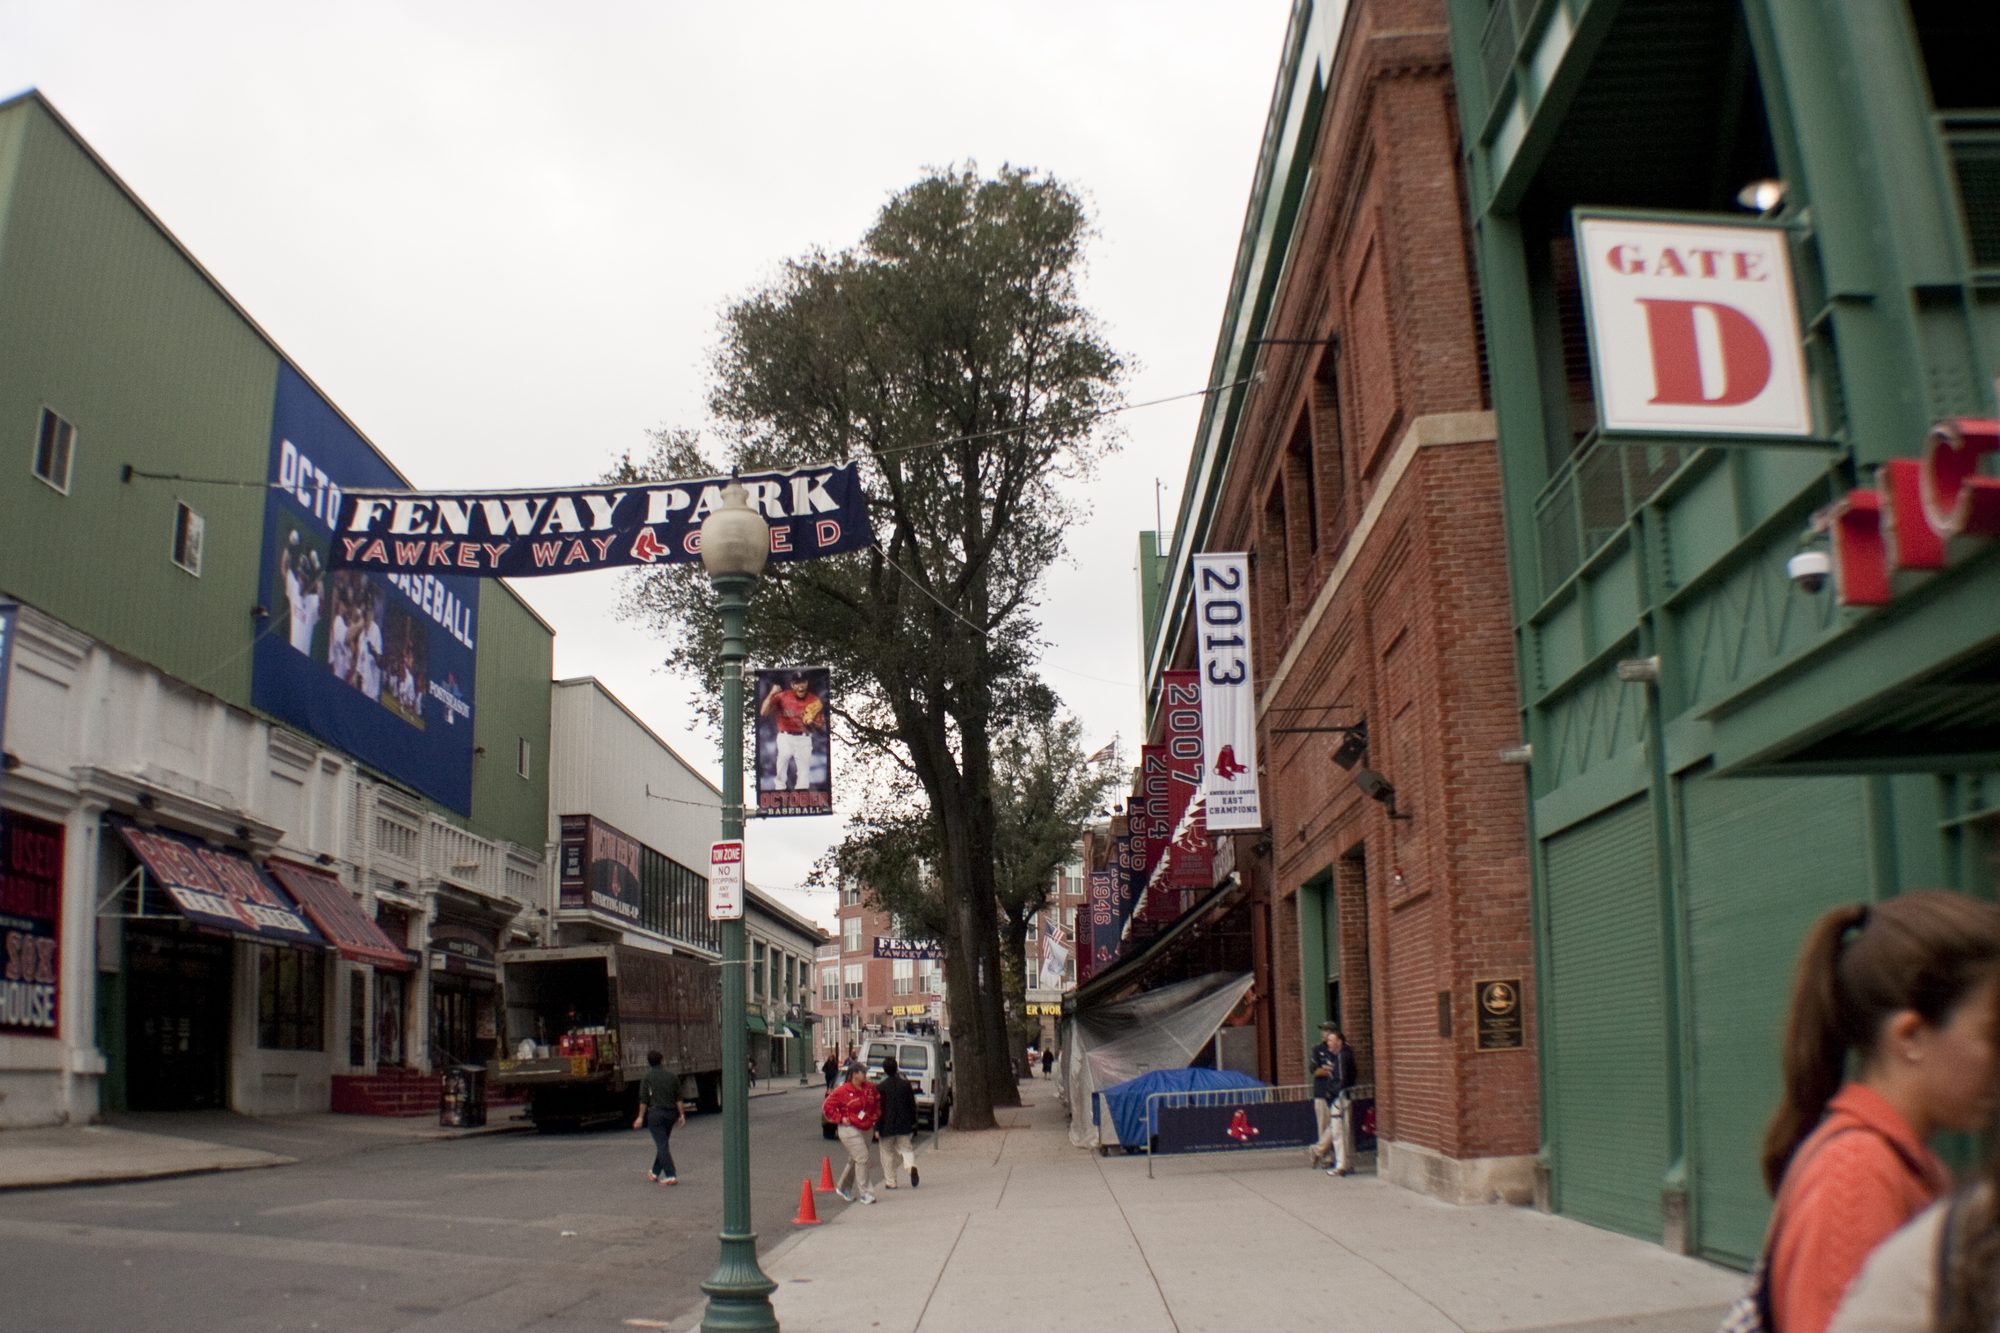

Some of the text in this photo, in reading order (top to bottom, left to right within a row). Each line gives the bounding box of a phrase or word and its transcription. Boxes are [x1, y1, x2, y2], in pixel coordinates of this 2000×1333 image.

[1606, 244, 1769, 283] GATE
[1634, 297, 1773, 407] D
[279, 438, 343, 532] OCTO
[347, 472, 841, 536] FENWAY PARK
[342, 519, 841, 569] YAWKEY WAY GE D
[1200, 566, 1248, 688] 2013
[1168, 683, 1204, 788] 2007
[760, 791, 829, 808] OCTOBER
[1209, 806, 1258, 814] CHAMPIONS
[712, 848, 740, 862] TOW ZONE
[718, 866, 731, 875] NO
[1092, 876, 1111, 925] 1946
[6, 930, 57, 983] SOX
[878, 938, 942, 951] FENWA
[878, 948, 922, 959] YAWKEY
[892, 1005, 906, 1016] BEER
[906, 1004, 925, 1015] WORKS
[1026, 1004, 1062, 1016] ER WOR
